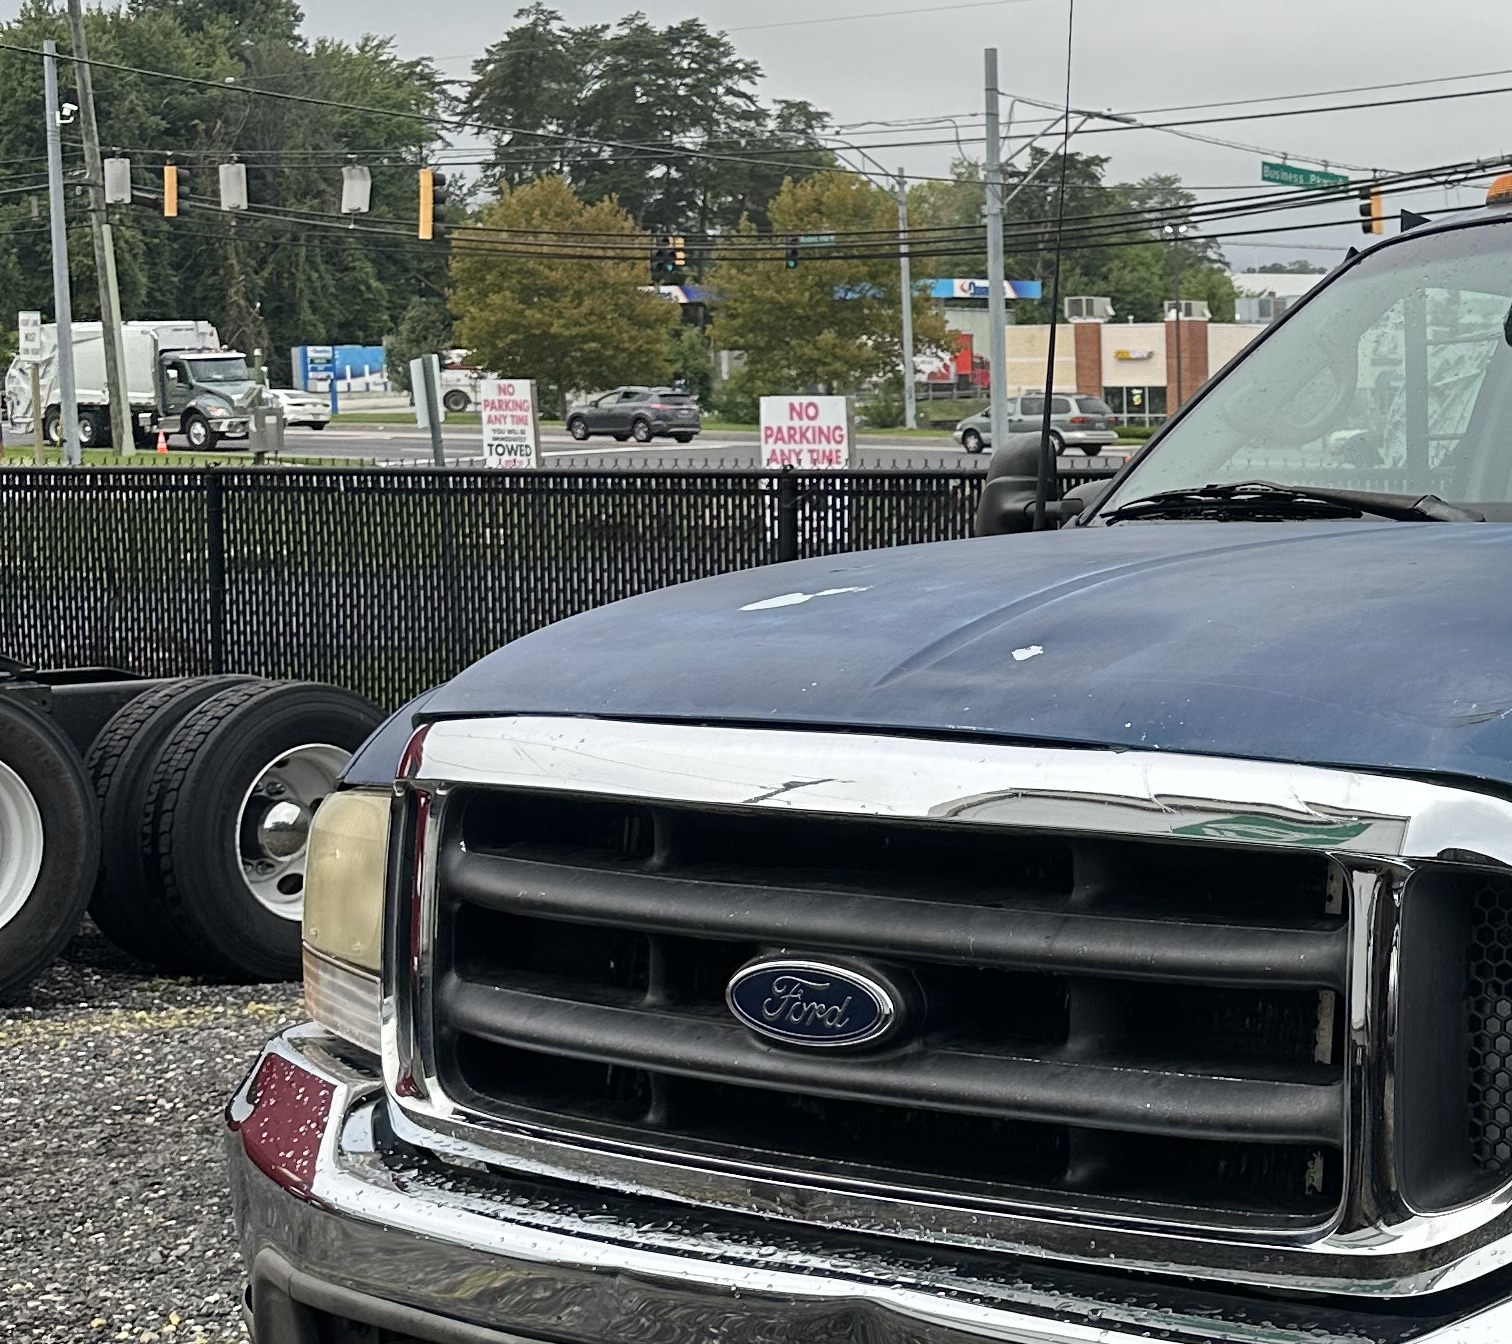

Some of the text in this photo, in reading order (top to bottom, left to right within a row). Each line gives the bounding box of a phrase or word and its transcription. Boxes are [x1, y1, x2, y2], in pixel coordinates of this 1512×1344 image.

[1263, 165, 1305, 185] Business
[497, 383, 515, 396] NO
[483, 399, 530, 412] PARKING
[788, 401, 819, 421] NO
[486, 414, 529, 426] ANY TIME
[764, 425, 845, 445] PARKING
[487, 443, 532, 457] TOWED
[769, 448, 842, 465] ANY TIME
[762, 975, 853, 1030] Ford
